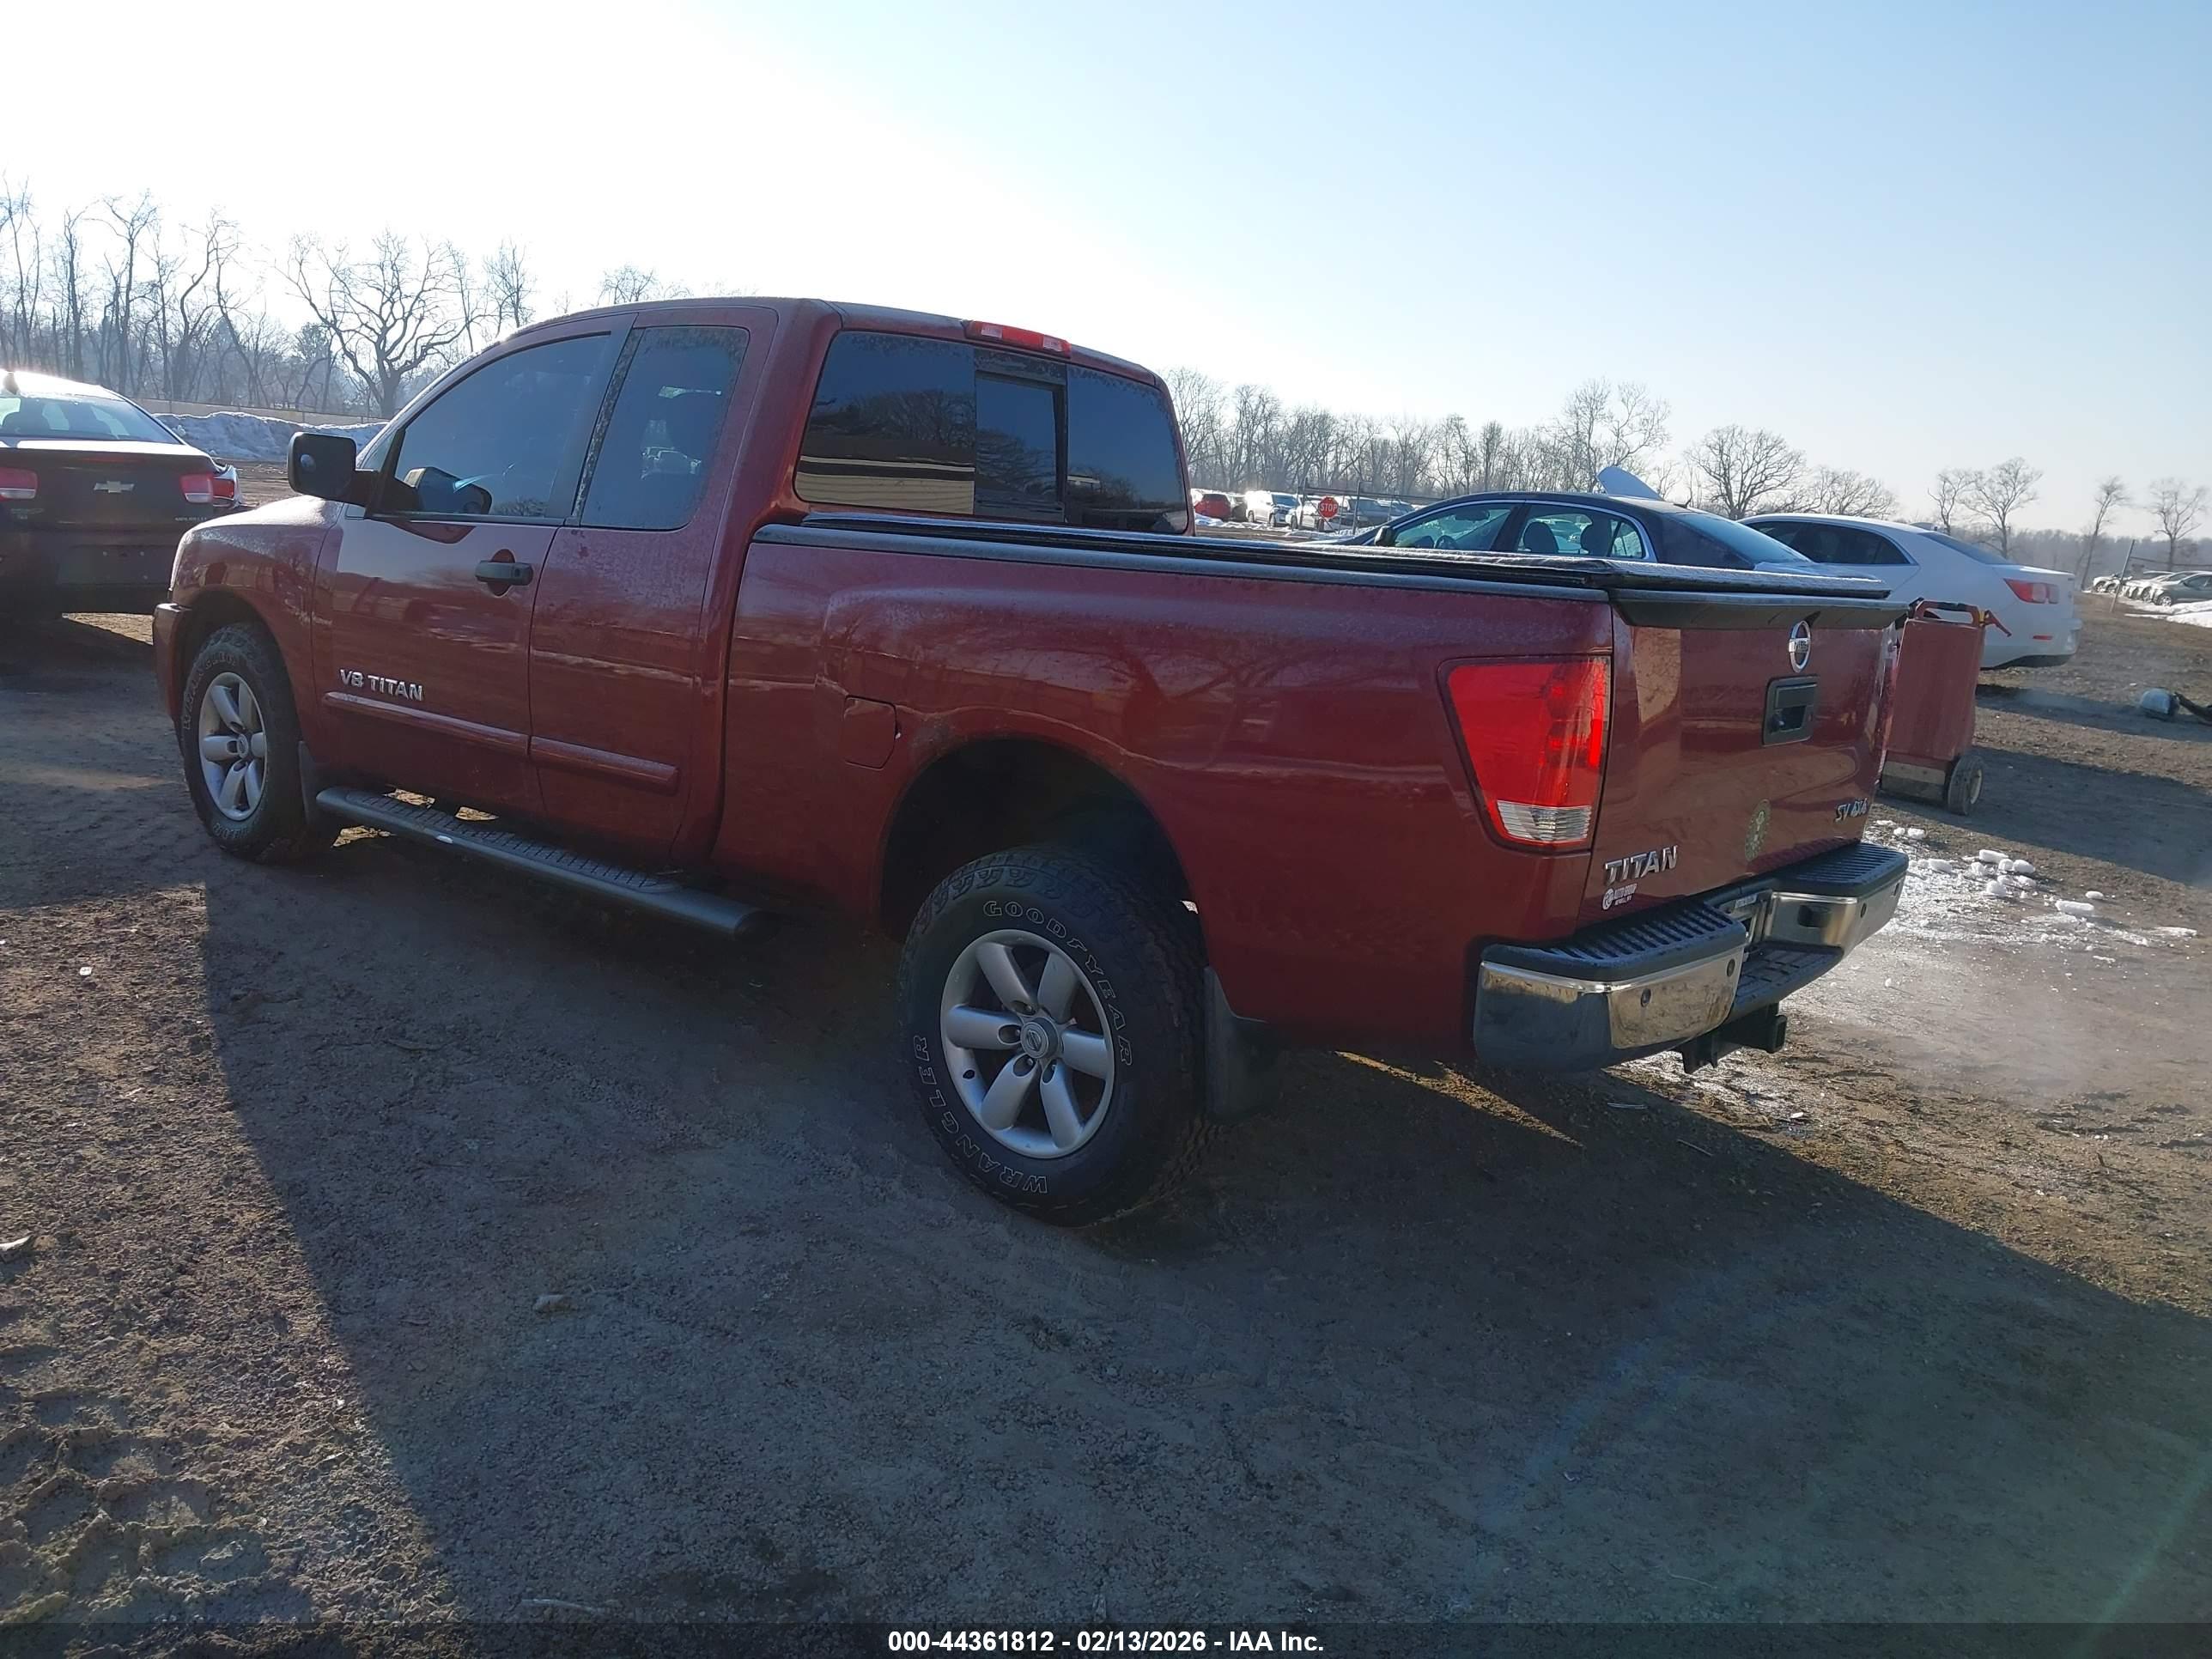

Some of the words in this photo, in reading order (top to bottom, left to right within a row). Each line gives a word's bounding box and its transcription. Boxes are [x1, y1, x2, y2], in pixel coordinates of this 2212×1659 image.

[1320, 502, 1338, 513] STOP
[340, 669, 364, 688] V8
[368, 675, 423, 702] TITAN
[1835, 803, 1851, 823] SV
[1605, 844, 1679, 887] TITAN
[983, 901, 1133, 1066] GOODYEAR
[913, 1035, 1048, 1194] WRANGLER
